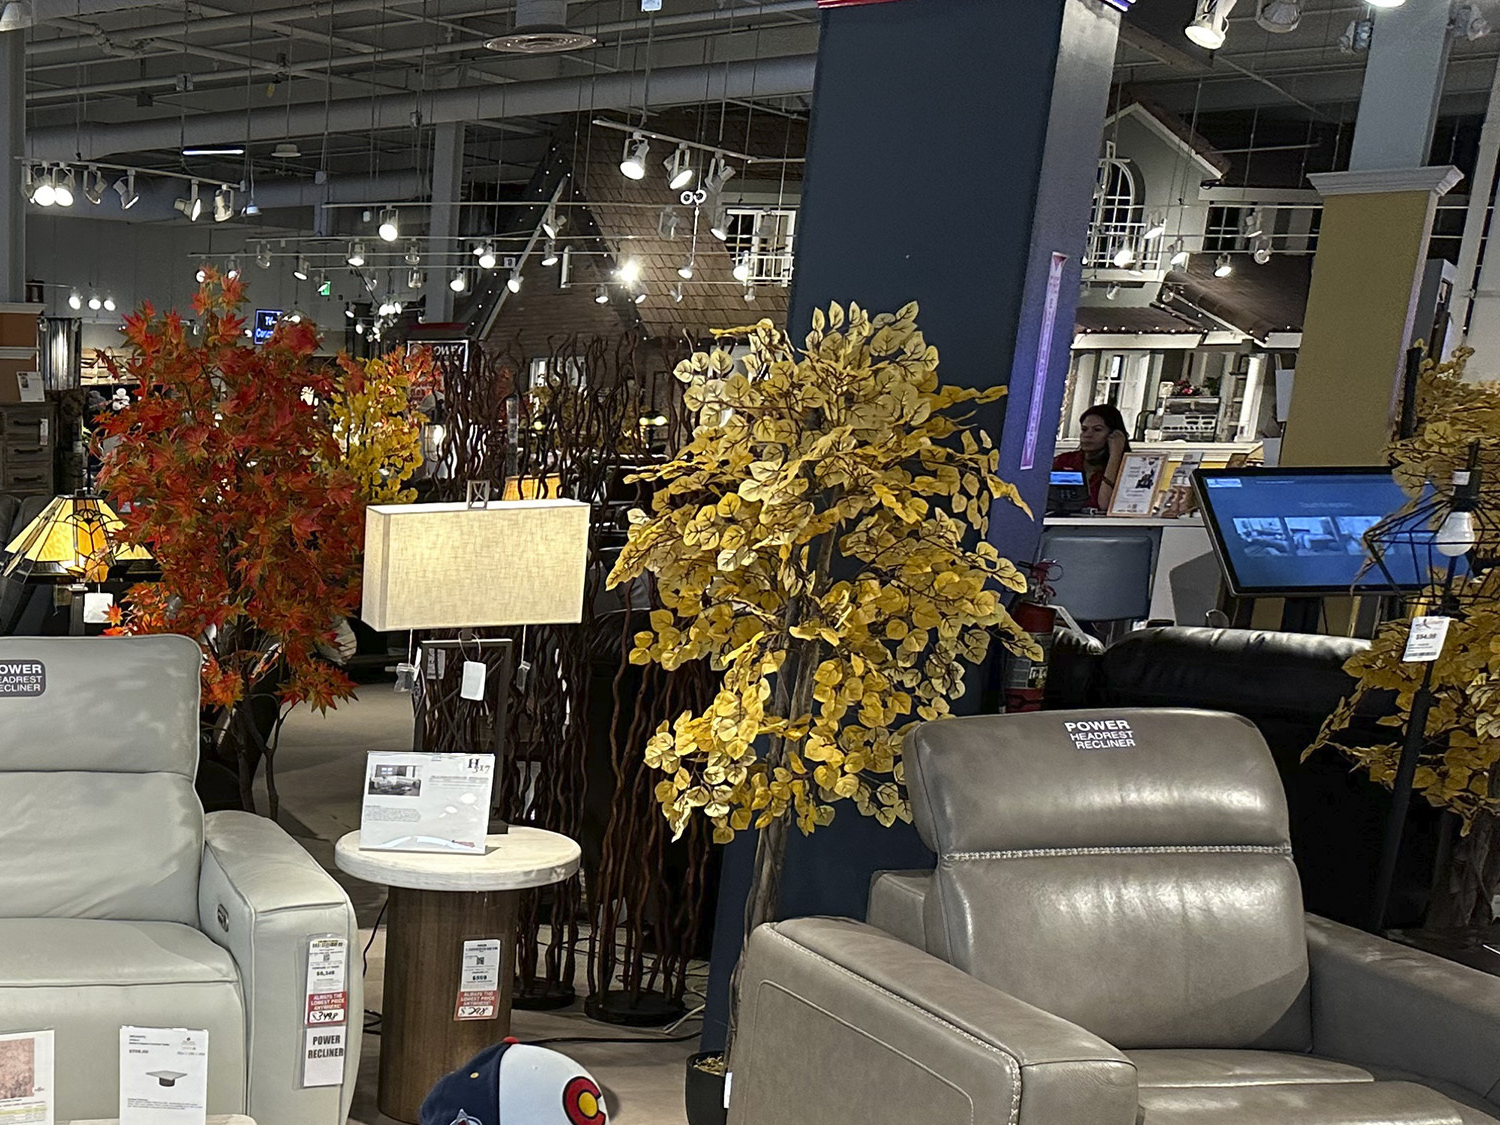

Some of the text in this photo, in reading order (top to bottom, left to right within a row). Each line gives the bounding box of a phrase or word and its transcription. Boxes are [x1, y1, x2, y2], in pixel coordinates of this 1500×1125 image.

[1064, 720, 1131, 732] POWER
[1069, 731, 1133, 741] HEADREST
[1075, 739, 1136, 750] RECLINER
[312, 1035, 341, 1045] POWER
[308, 1048, 344, 1059] RECLINER
